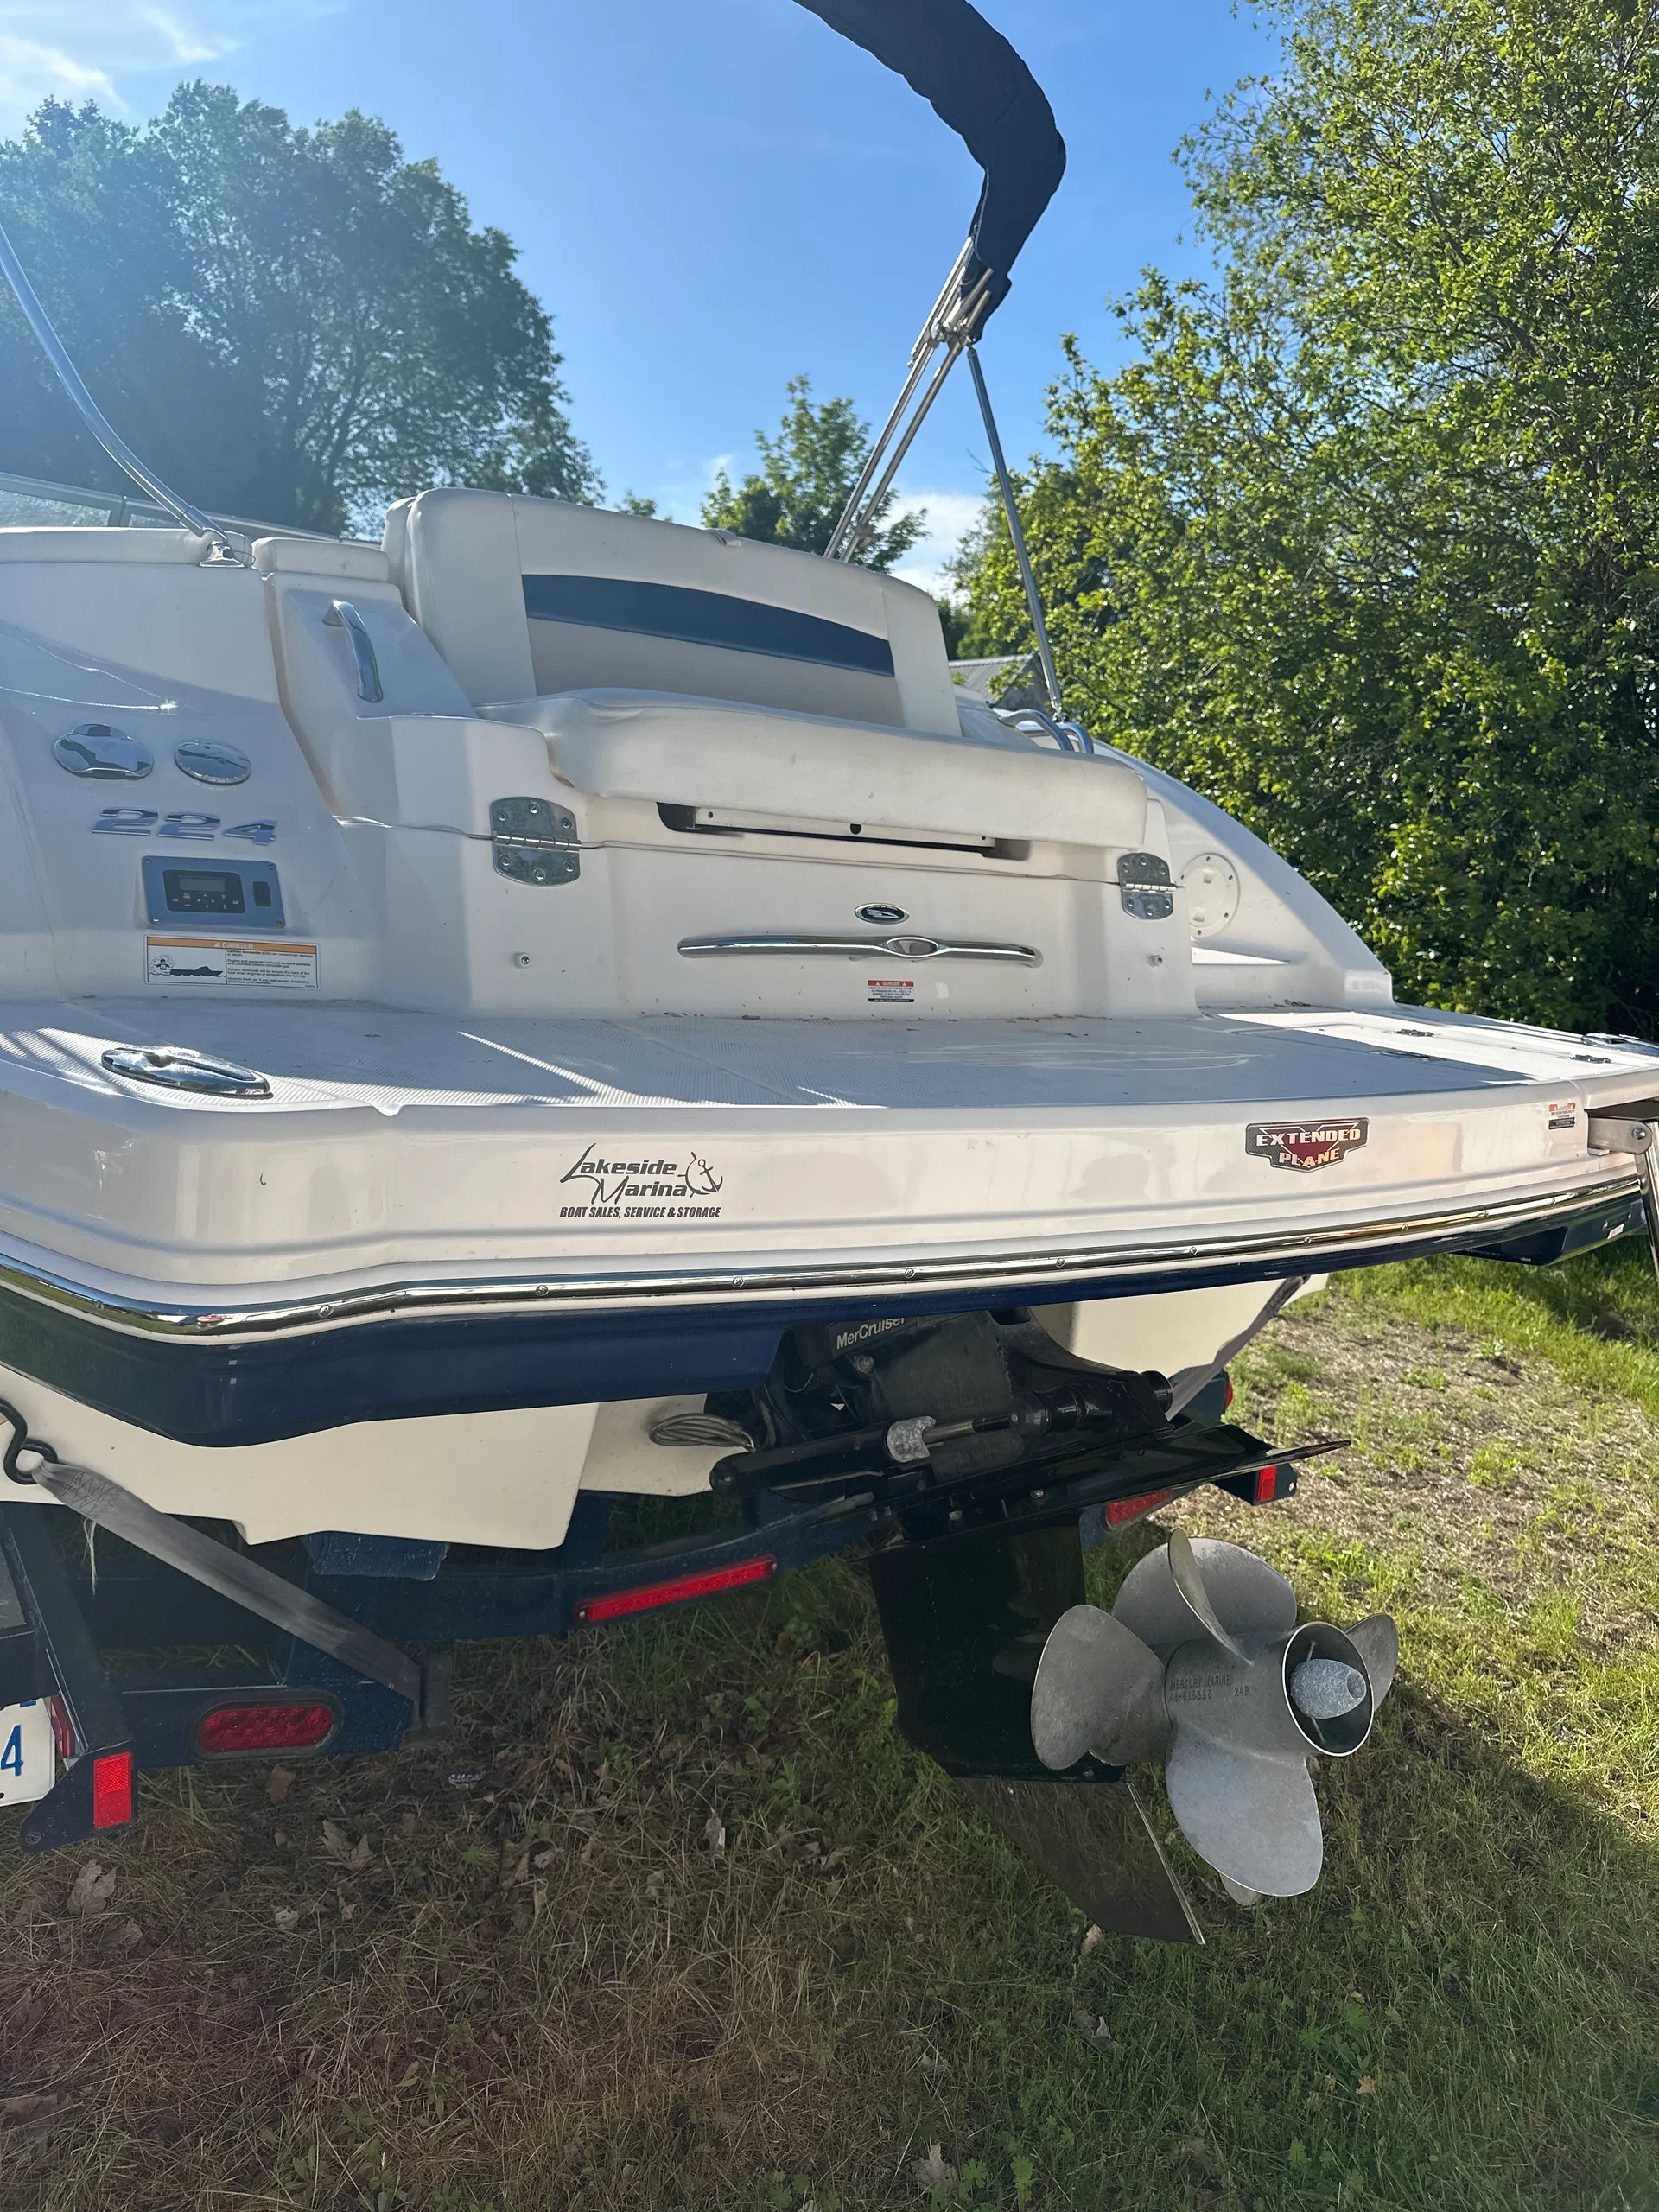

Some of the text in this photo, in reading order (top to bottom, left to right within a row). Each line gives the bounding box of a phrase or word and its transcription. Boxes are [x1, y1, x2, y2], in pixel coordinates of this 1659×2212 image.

[92, 807, 277, 846] 224
[1256, 1128, 1361, 1147] EXTENDED
[560, 1142, 677, 1183] Lakeside
[1279, 1147, 1340, 1167] PLANE
[591, 1175, 688, 1205] Marina
[559, 1206, 721, 1219] BOAT SALES, SERVICE & STORAGE
